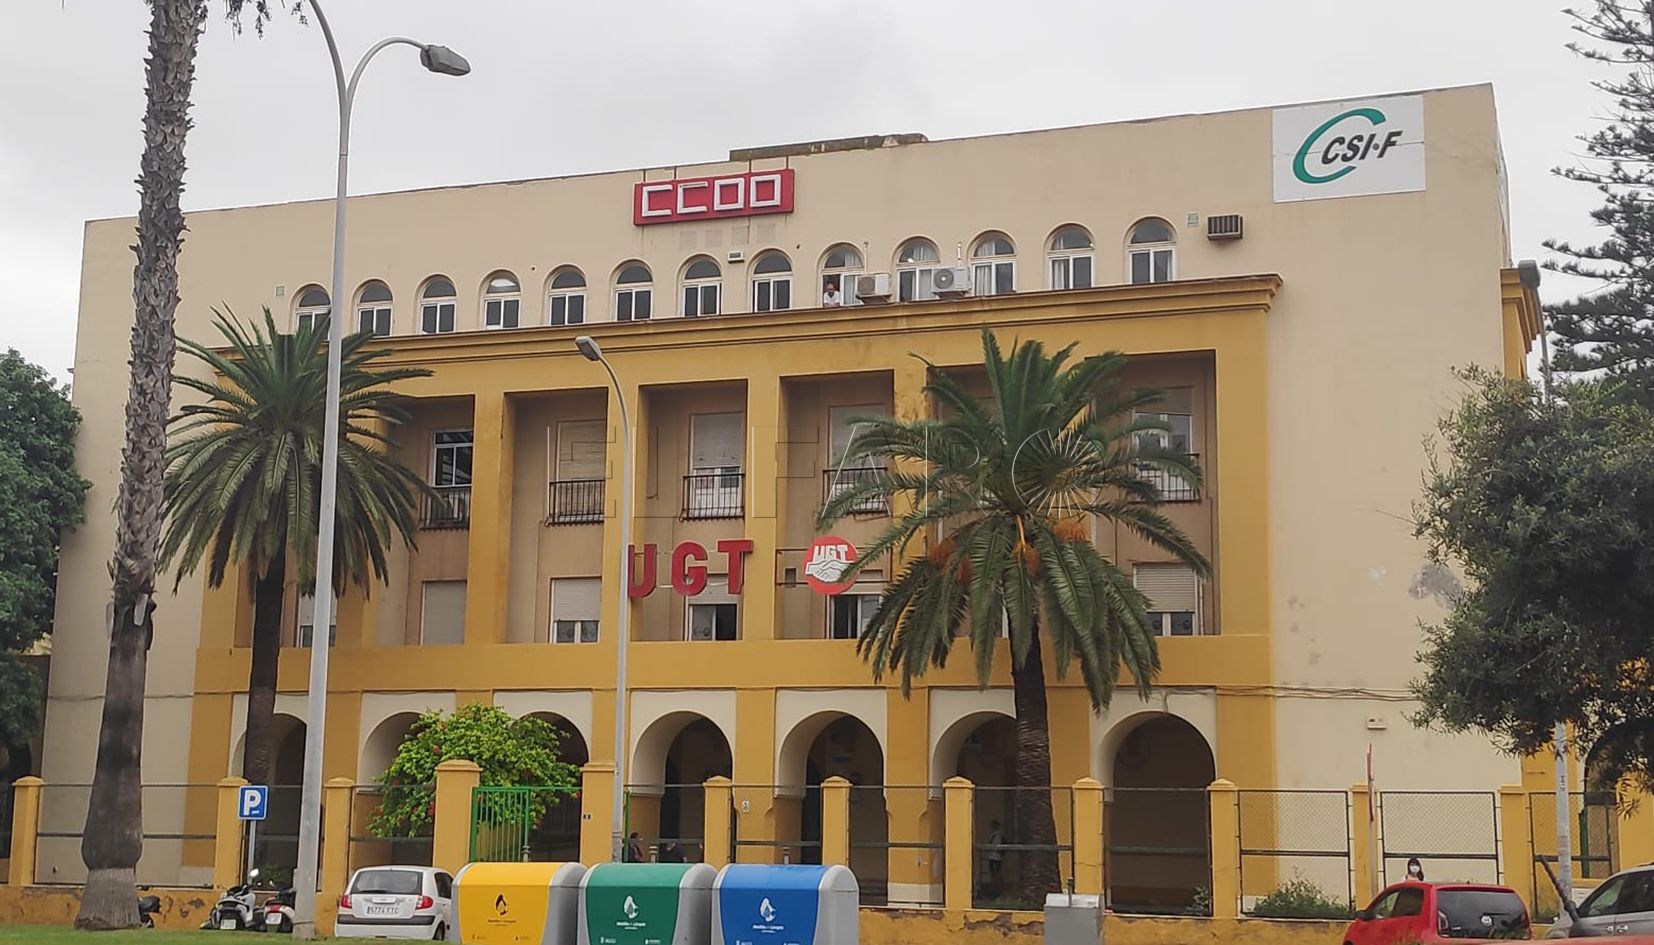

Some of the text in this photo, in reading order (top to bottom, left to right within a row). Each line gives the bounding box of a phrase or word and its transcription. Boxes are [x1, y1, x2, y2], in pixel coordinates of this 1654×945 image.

[641, 174, 781, 217] CCOO
[627, 539, 754, 599] UGT
[812, 544, 848, 561] UGT
[243, 789, 262, 816] P
